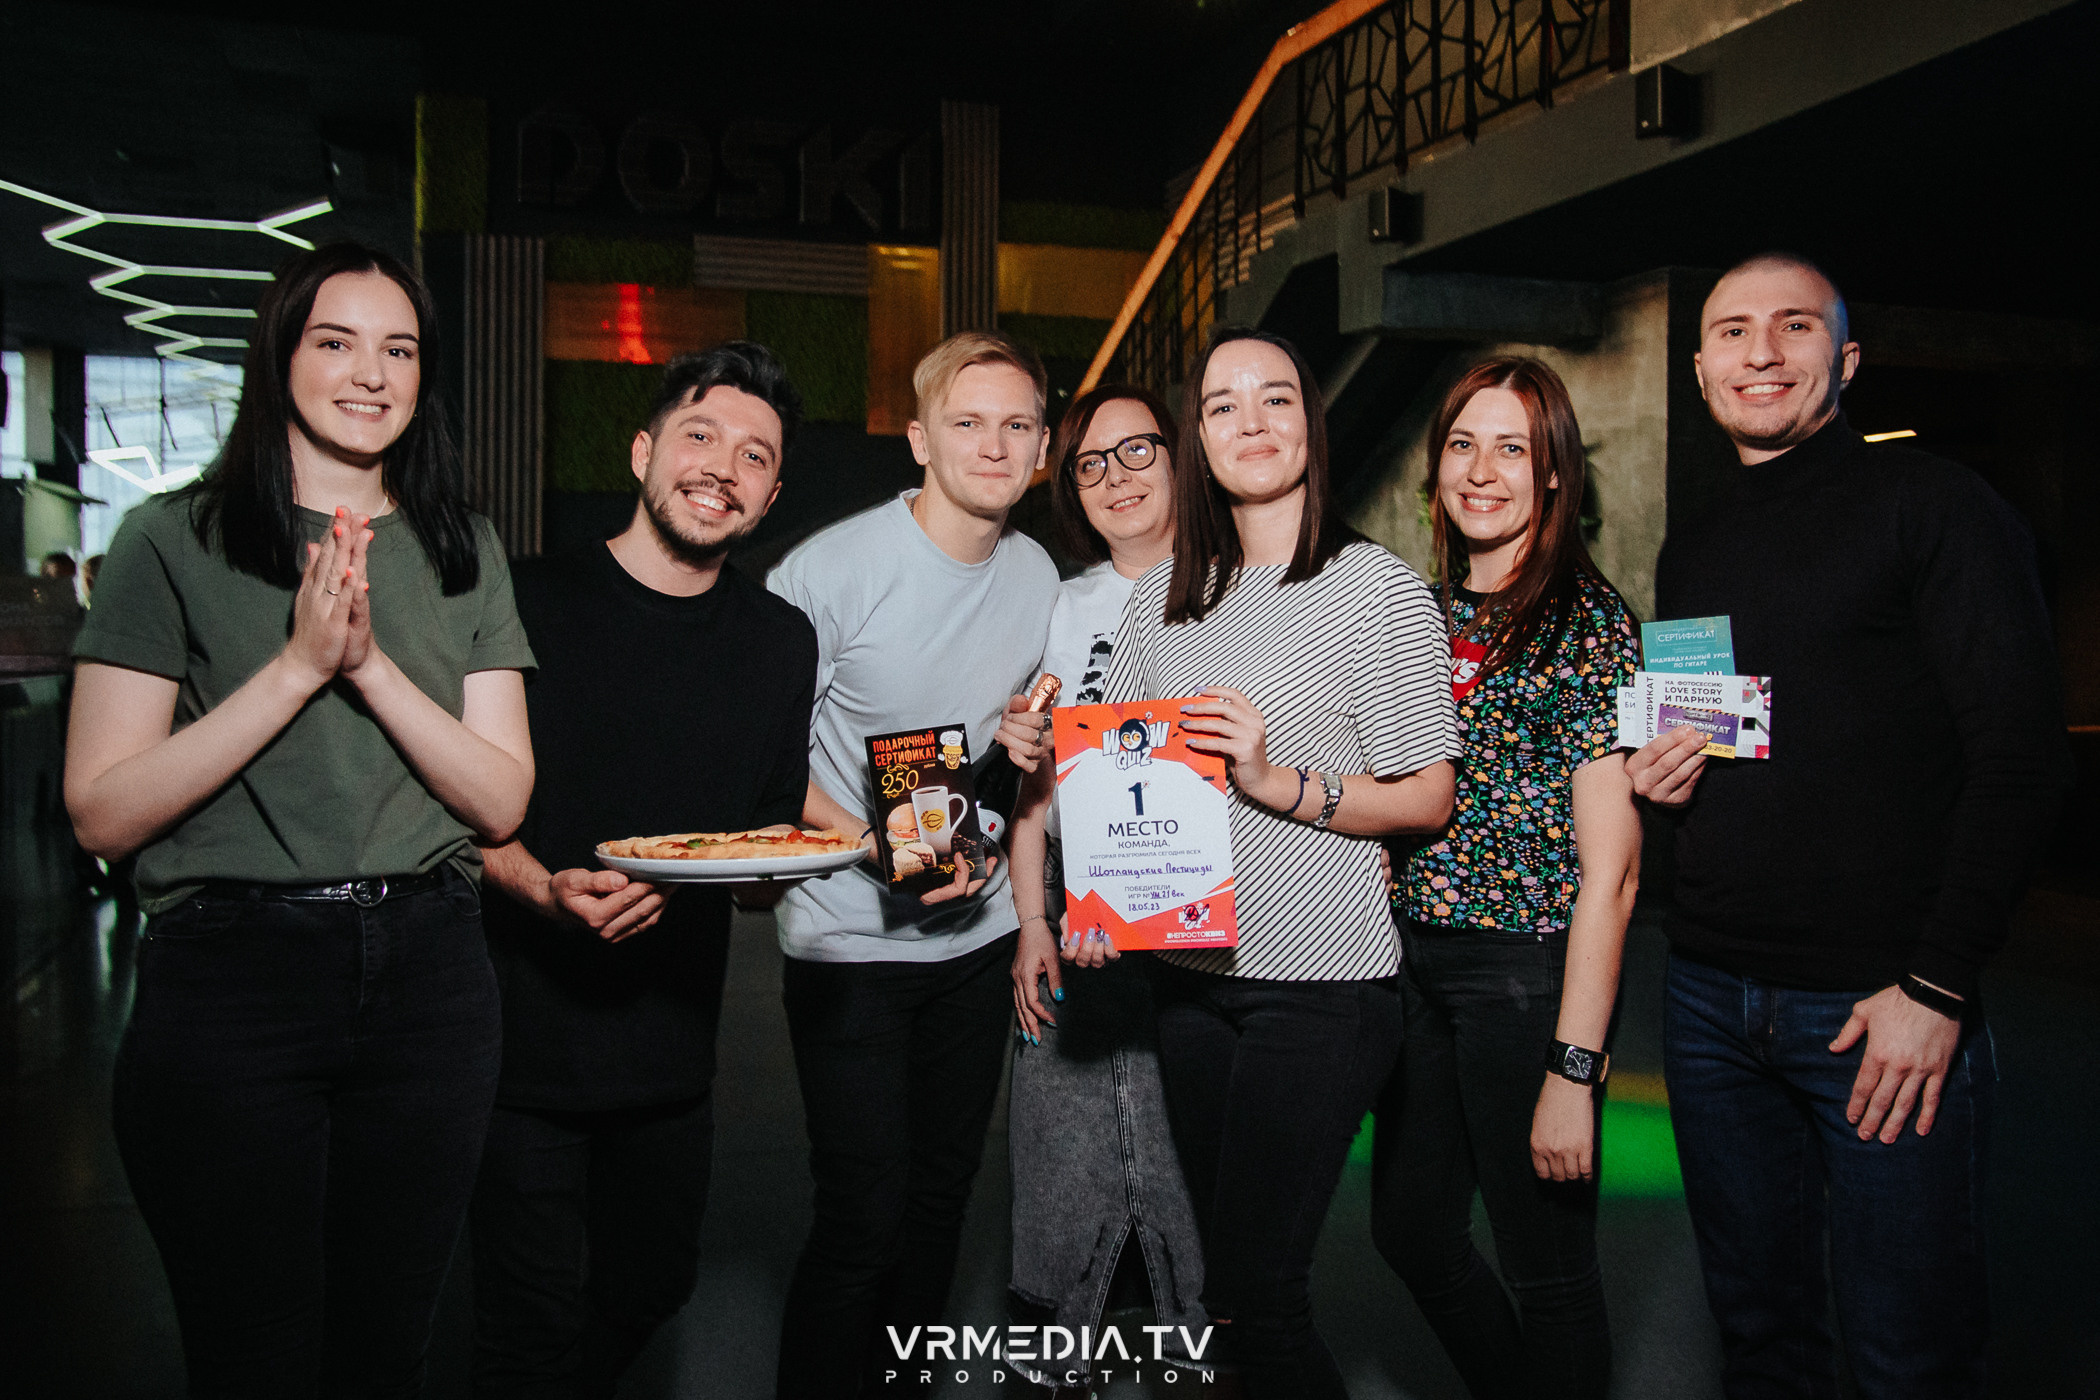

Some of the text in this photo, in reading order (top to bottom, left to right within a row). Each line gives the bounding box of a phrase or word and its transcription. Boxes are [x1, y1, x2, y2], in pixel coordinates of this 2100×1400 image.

[517, 112, 932, 231] DOSKI
[1657, 630, 1715, 643] СЕРТИФИКАТ
[1650, 652, 1730, 664] ИНДИВИДУАЛЬНЫЙ УРОК
[1677, 680, 1723, 688] ФОТОСЕССИЮ
[1675, 695, 1723, 704] ПАРНУЮ
[1691, 688, 1723, 696] STORY
[872, 730, 936, 753] ПОДАРОЧНЫЙ
[875, 746, 936, 767] СЕРТИФИКАТ
[1116, 746, 1153, 771] QUIZ
[881, 769, 919, 794] 250
[1128, 782, 1144, 816] 1
[1108, 819, 1179, 837] МЕСТО
[1088, 862, 1213, 879] Шотландские Пестициды
[1124, 884, 1171, 892] ПОБЕДИТЕЛИ
[1128, 892, 1142, 900] ИГР
[1128, 902, 1160, 912] 18.05.23
